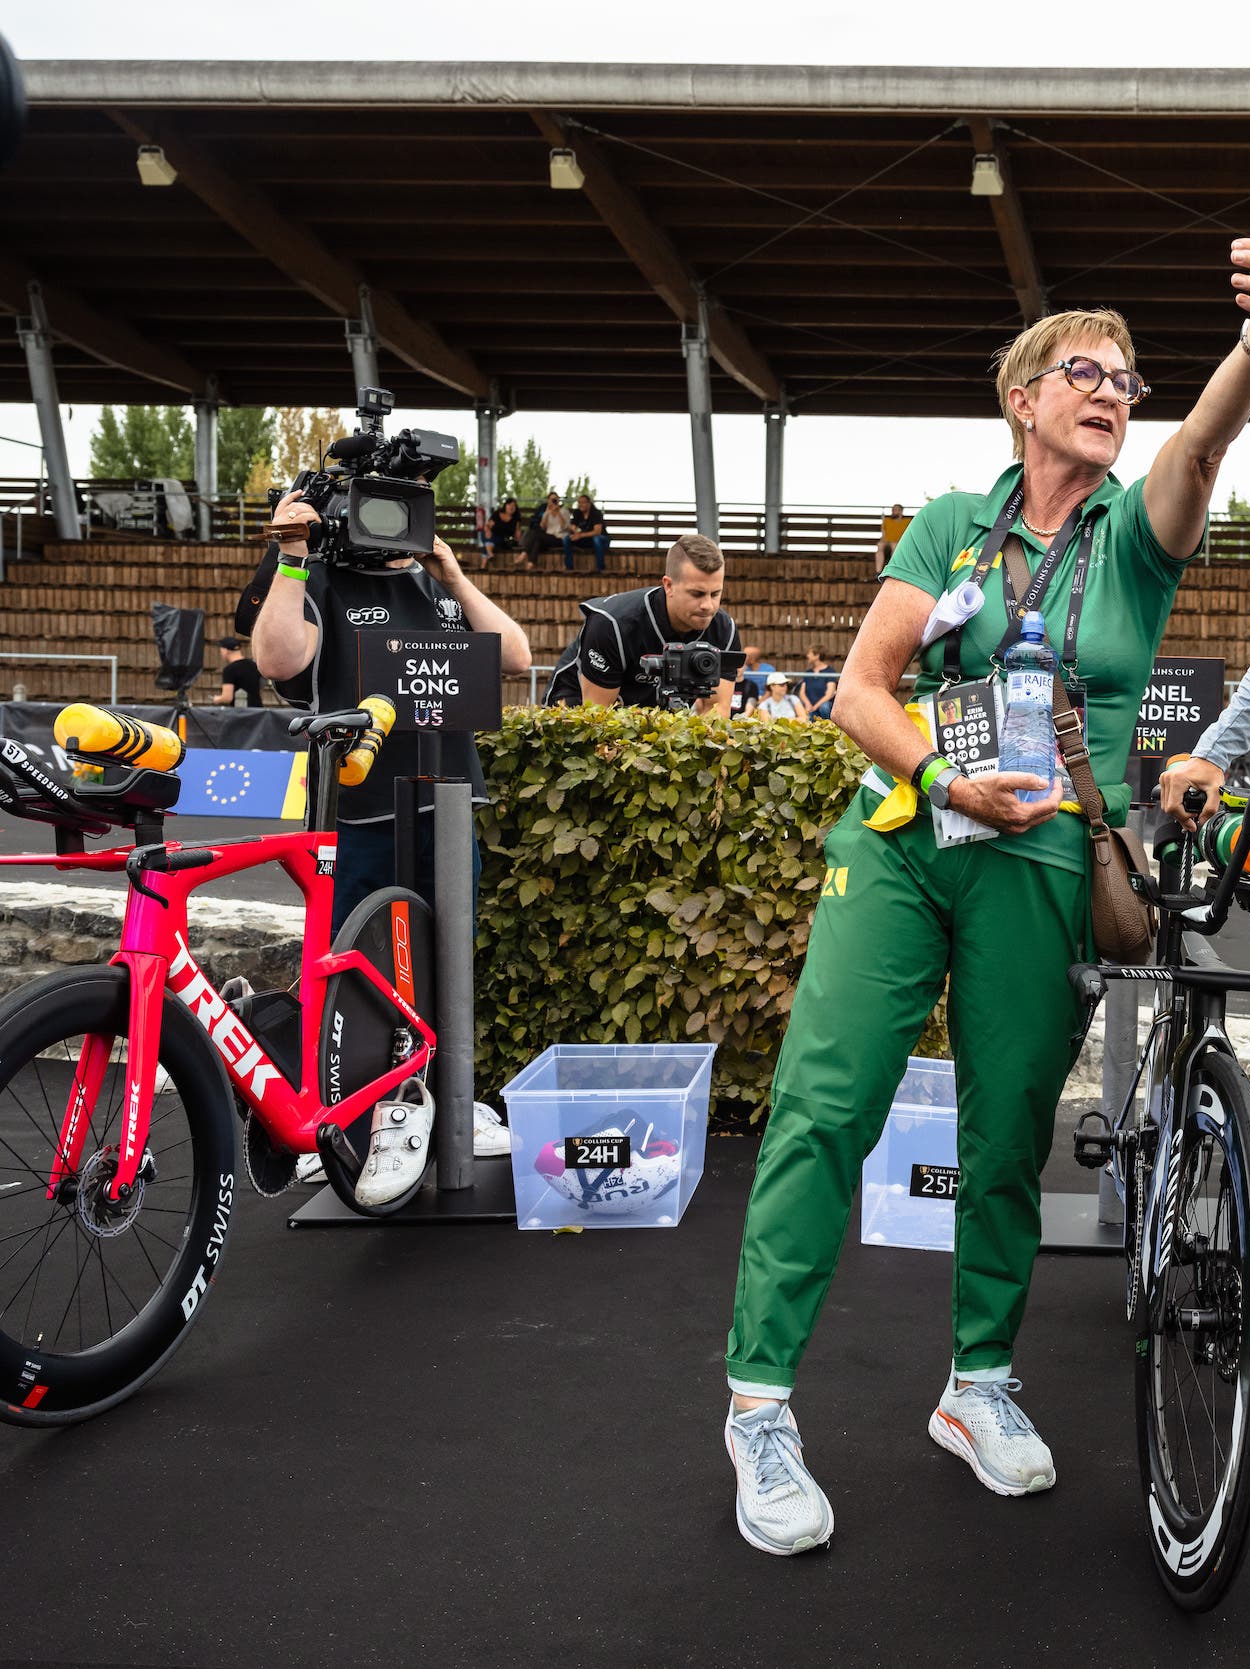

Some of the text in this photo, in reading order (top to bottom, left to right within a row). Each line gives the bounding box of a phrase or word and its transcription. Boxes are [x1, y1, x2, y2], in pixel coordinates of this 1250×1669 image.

[1025, 549, 1058, 606] COLLINS CUP
[348, 609, 388, 622] PTO
[404, 642, 447, 650] COLLINS
[405, 659, 450, 676] SAM
[1151, 668, 1195, 676] LINS CUP
[397, 678, 460, 695] LONG
[414, 700, 443, 709] TEAM
[414, 708, 444, 726] US
[1136, 727, 1167, 737] TEAM
[1137, 737, 1167, 751] INT
[7, 746, 20, 760] 51
[20, 759, 69, 801] SPEEDSHOP
[318, 861, 333, 875] 24H
[1120, 968, 1173, 981] CANYON
[391, 988, 421, 1024] TREK
[169, 930, 282, 1101] TREK
[330, 1010, 344, 1104] DT SWIS
[125, 1080, 140, 1161] TREK
[577, 1146, 619, 1164] 24H
[181, 1173, 234, 1321] DT SWISS
